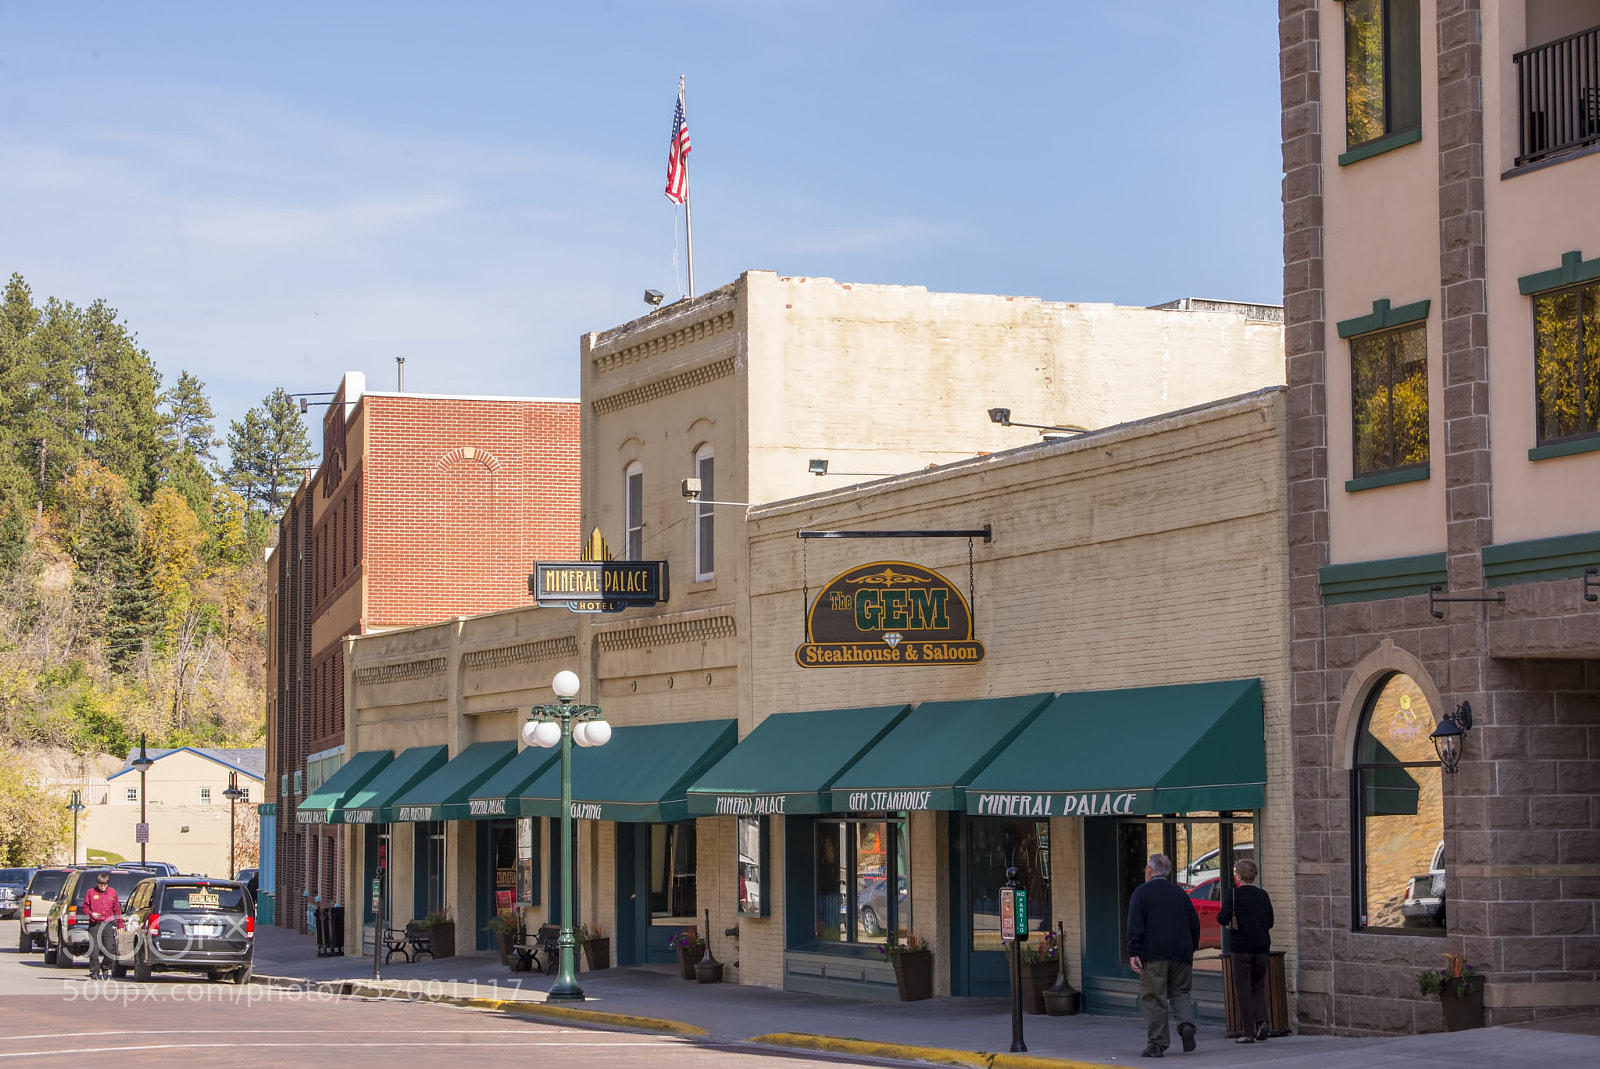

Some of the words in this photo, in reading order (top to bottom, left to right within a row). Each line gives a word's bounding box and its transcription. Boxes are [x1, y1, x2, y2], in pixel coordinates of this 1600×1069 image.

[546, 570, 599, 592] MINERAL
[604, 570, 648, 592] PALACE
[579, 602, 615, 610] HOTEL
[830, 591, 852, 611] The
[855, 587, 950, 632] GEM
[806, 645, 900, 663] Steakhouse
[905, 645, 918, 661] &
[923, 643, 978, 660] Saloon
[715, 796, 752, 815] MINERAL
[754, 796, 786, 815] PALACE
[849, 791, 868, 810] GEM
[870, 791, 931, 810] STEAKHOUSE
[977, 793, 1053, 816] MINERAL
[1063, 793, 1137, 816] PALACE
[570, 802, 602, 820] GAMING
